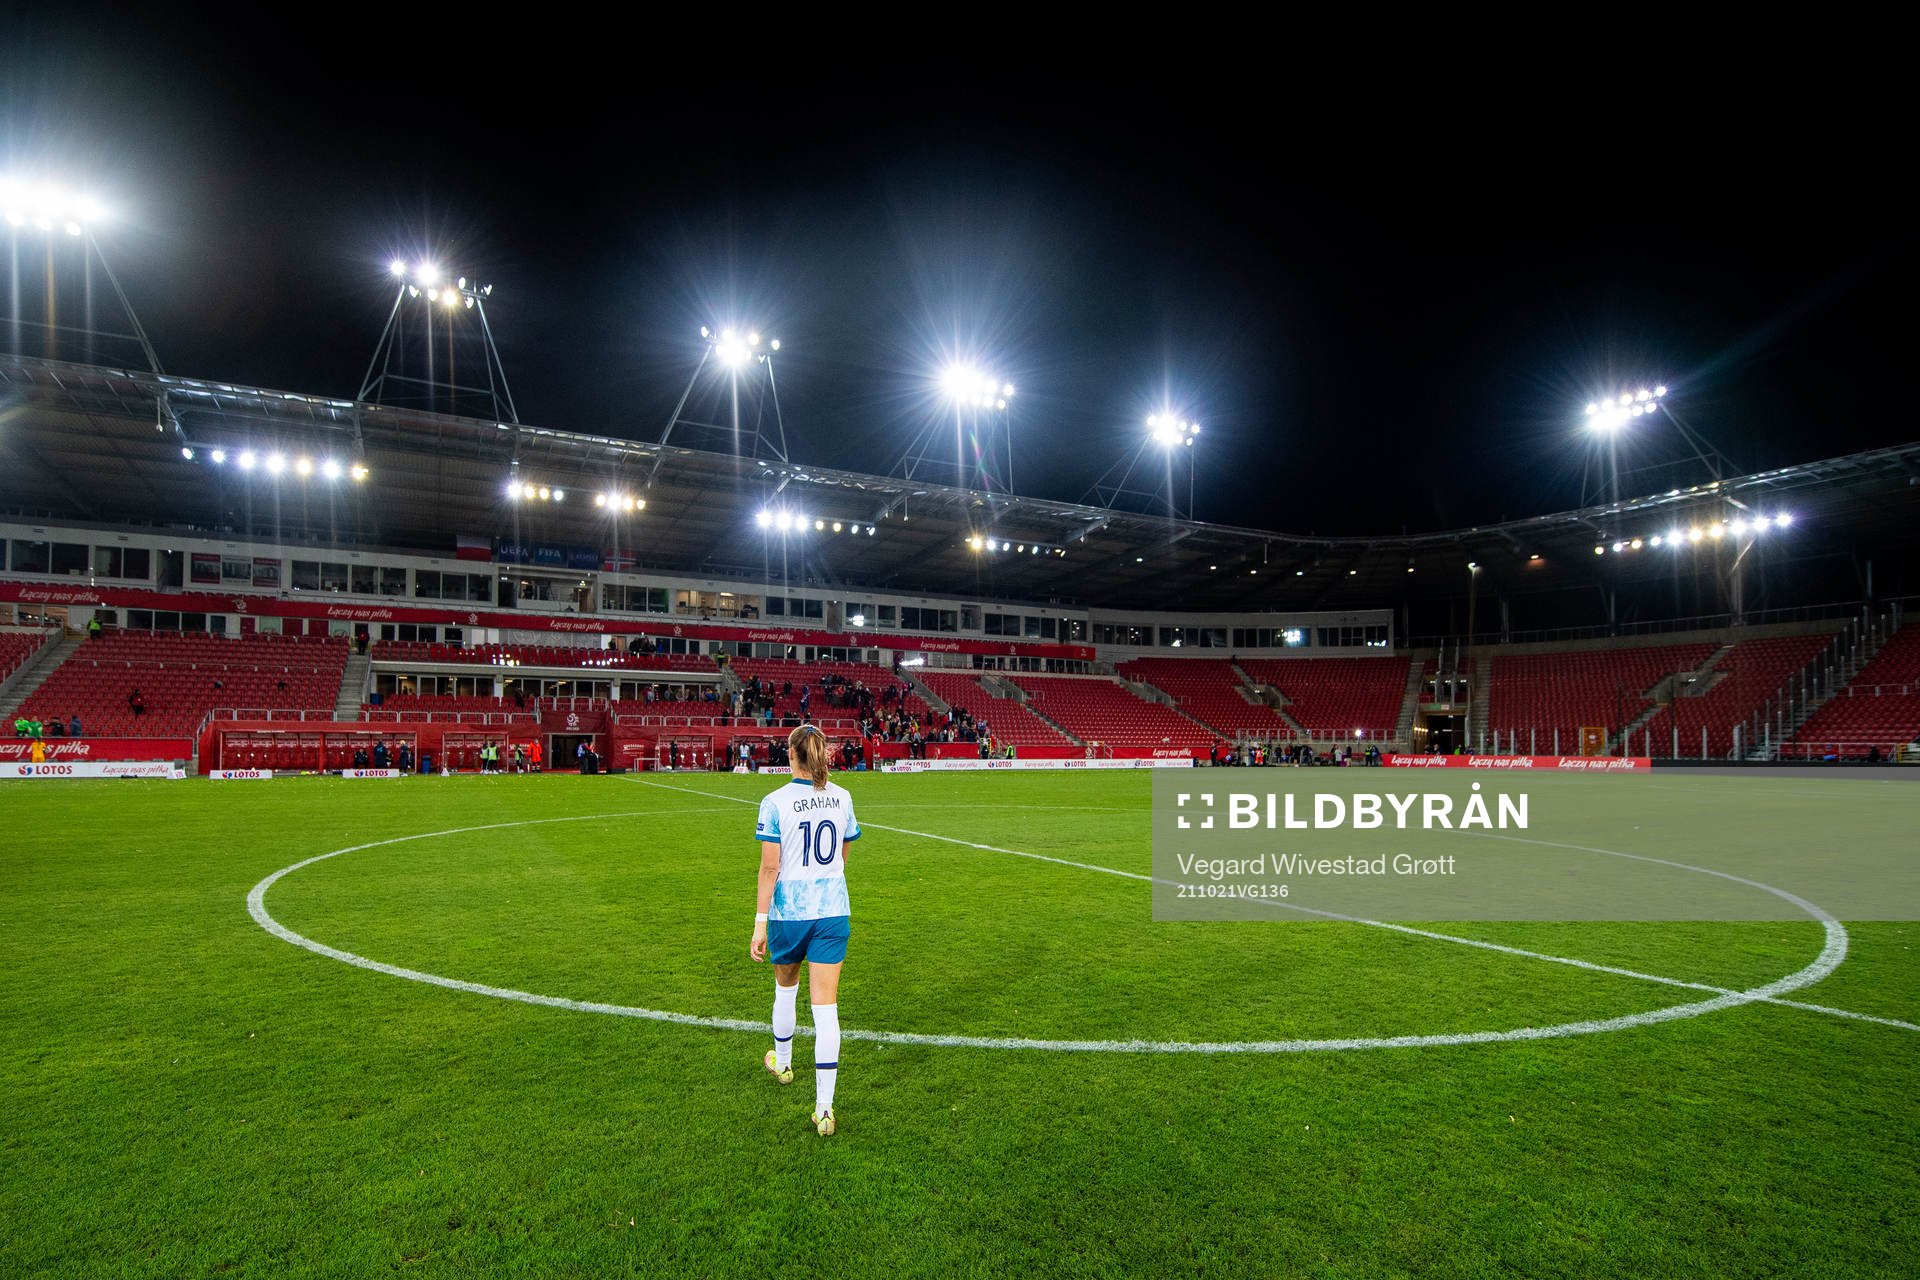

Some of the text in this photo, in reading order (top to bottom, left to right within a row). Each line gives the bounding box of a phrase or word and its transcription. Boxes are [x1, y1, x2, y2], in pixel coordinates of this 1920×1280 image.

[500, 544, 529, 557] UEFA
[538, 547, 561, 558] FIFA
[18, 588, 100, 603] Łączy nas piłka
[328, 606, 354, 619] Łączy
[369, 609, 392, 619] piłka
[550, 620, 572, 630] Łączy
[51, 741, 90, 758] piłka
[1391, 755, 1411, 767] Łączy
[1468, 756, 1492, 768] Łączy
[1508, 757, 1533, 769] piłka
[1558, 757, 1635, 772] Łączy nas piłka
[36, 766, 72, 774] LOTOS
[793, 797, 840, 813] GRAHAM
[798, 820, 837, 867] 10
